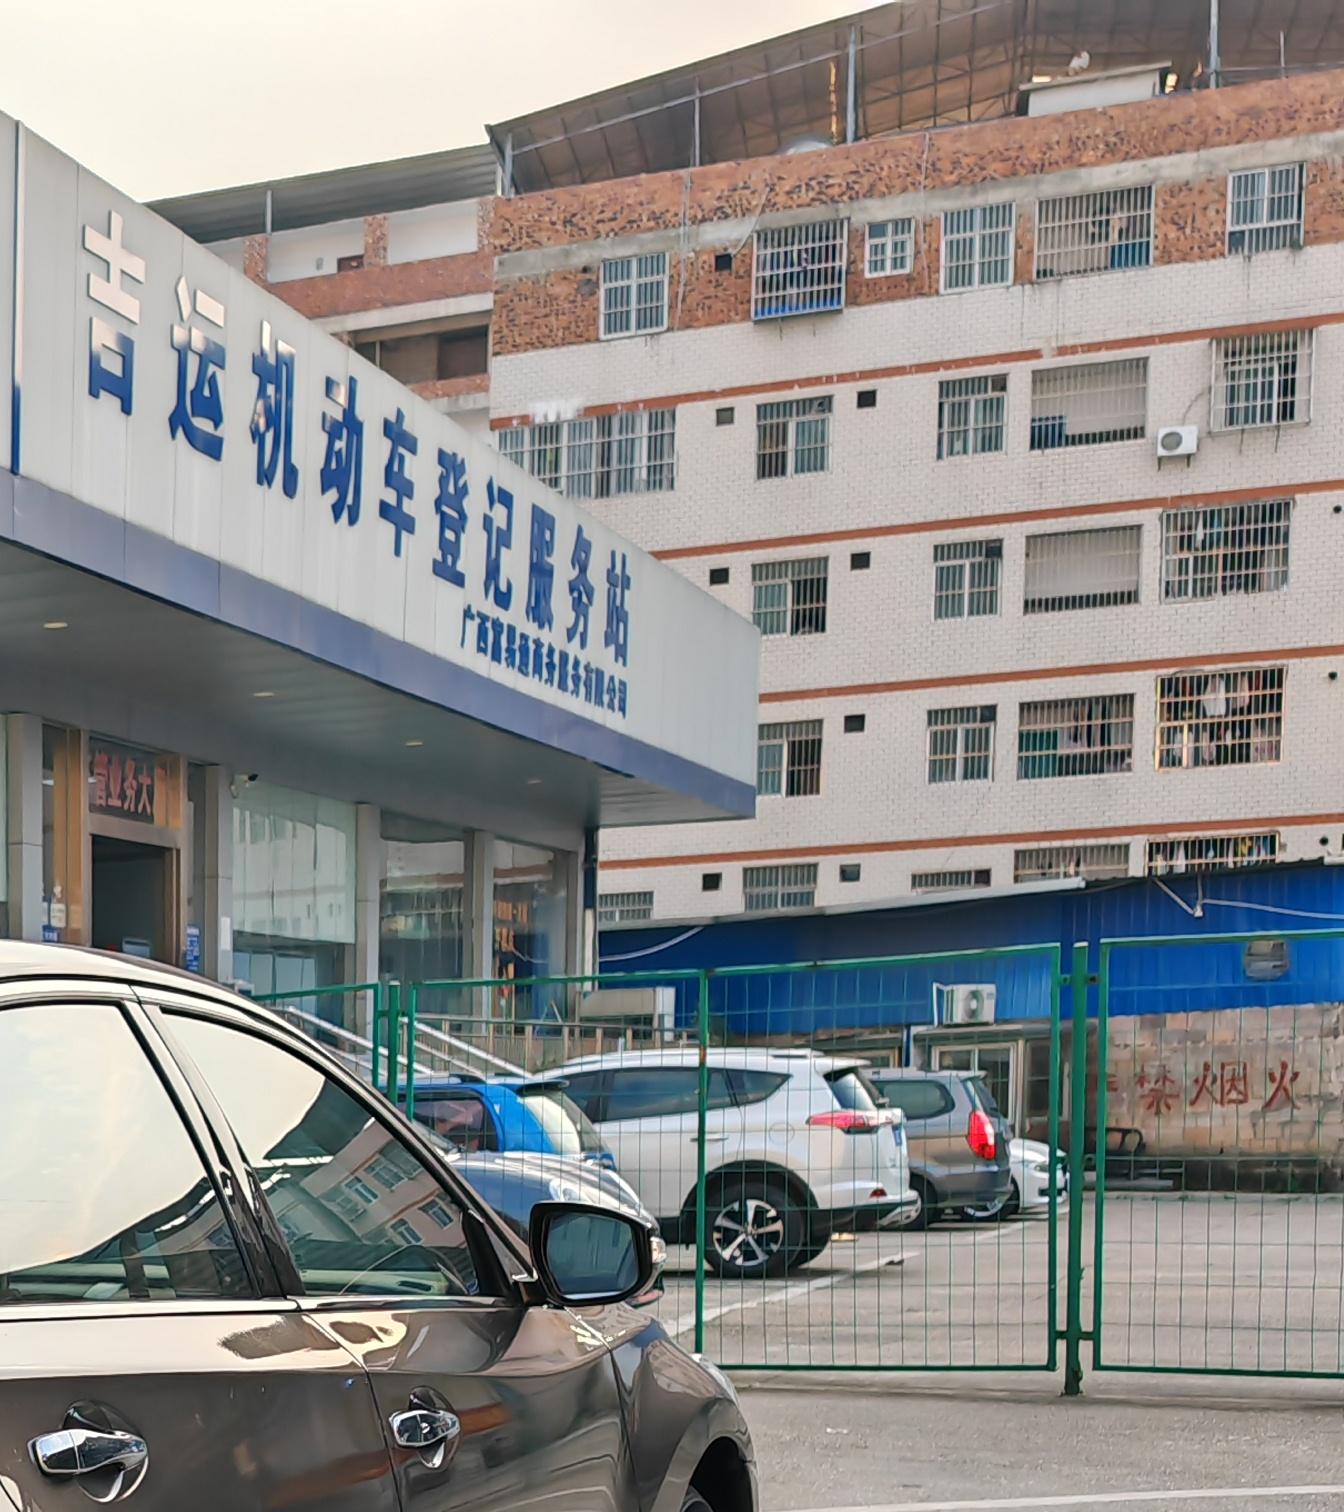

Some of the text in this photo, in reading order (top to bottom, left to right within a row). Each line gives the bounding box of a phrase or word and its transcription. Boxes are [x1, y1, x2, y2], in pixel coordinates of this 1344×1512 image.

[83, 210, 633, 669] 吉运机动车登记服务站
[1088, 1060, 1300, 1114] 禁烟火
